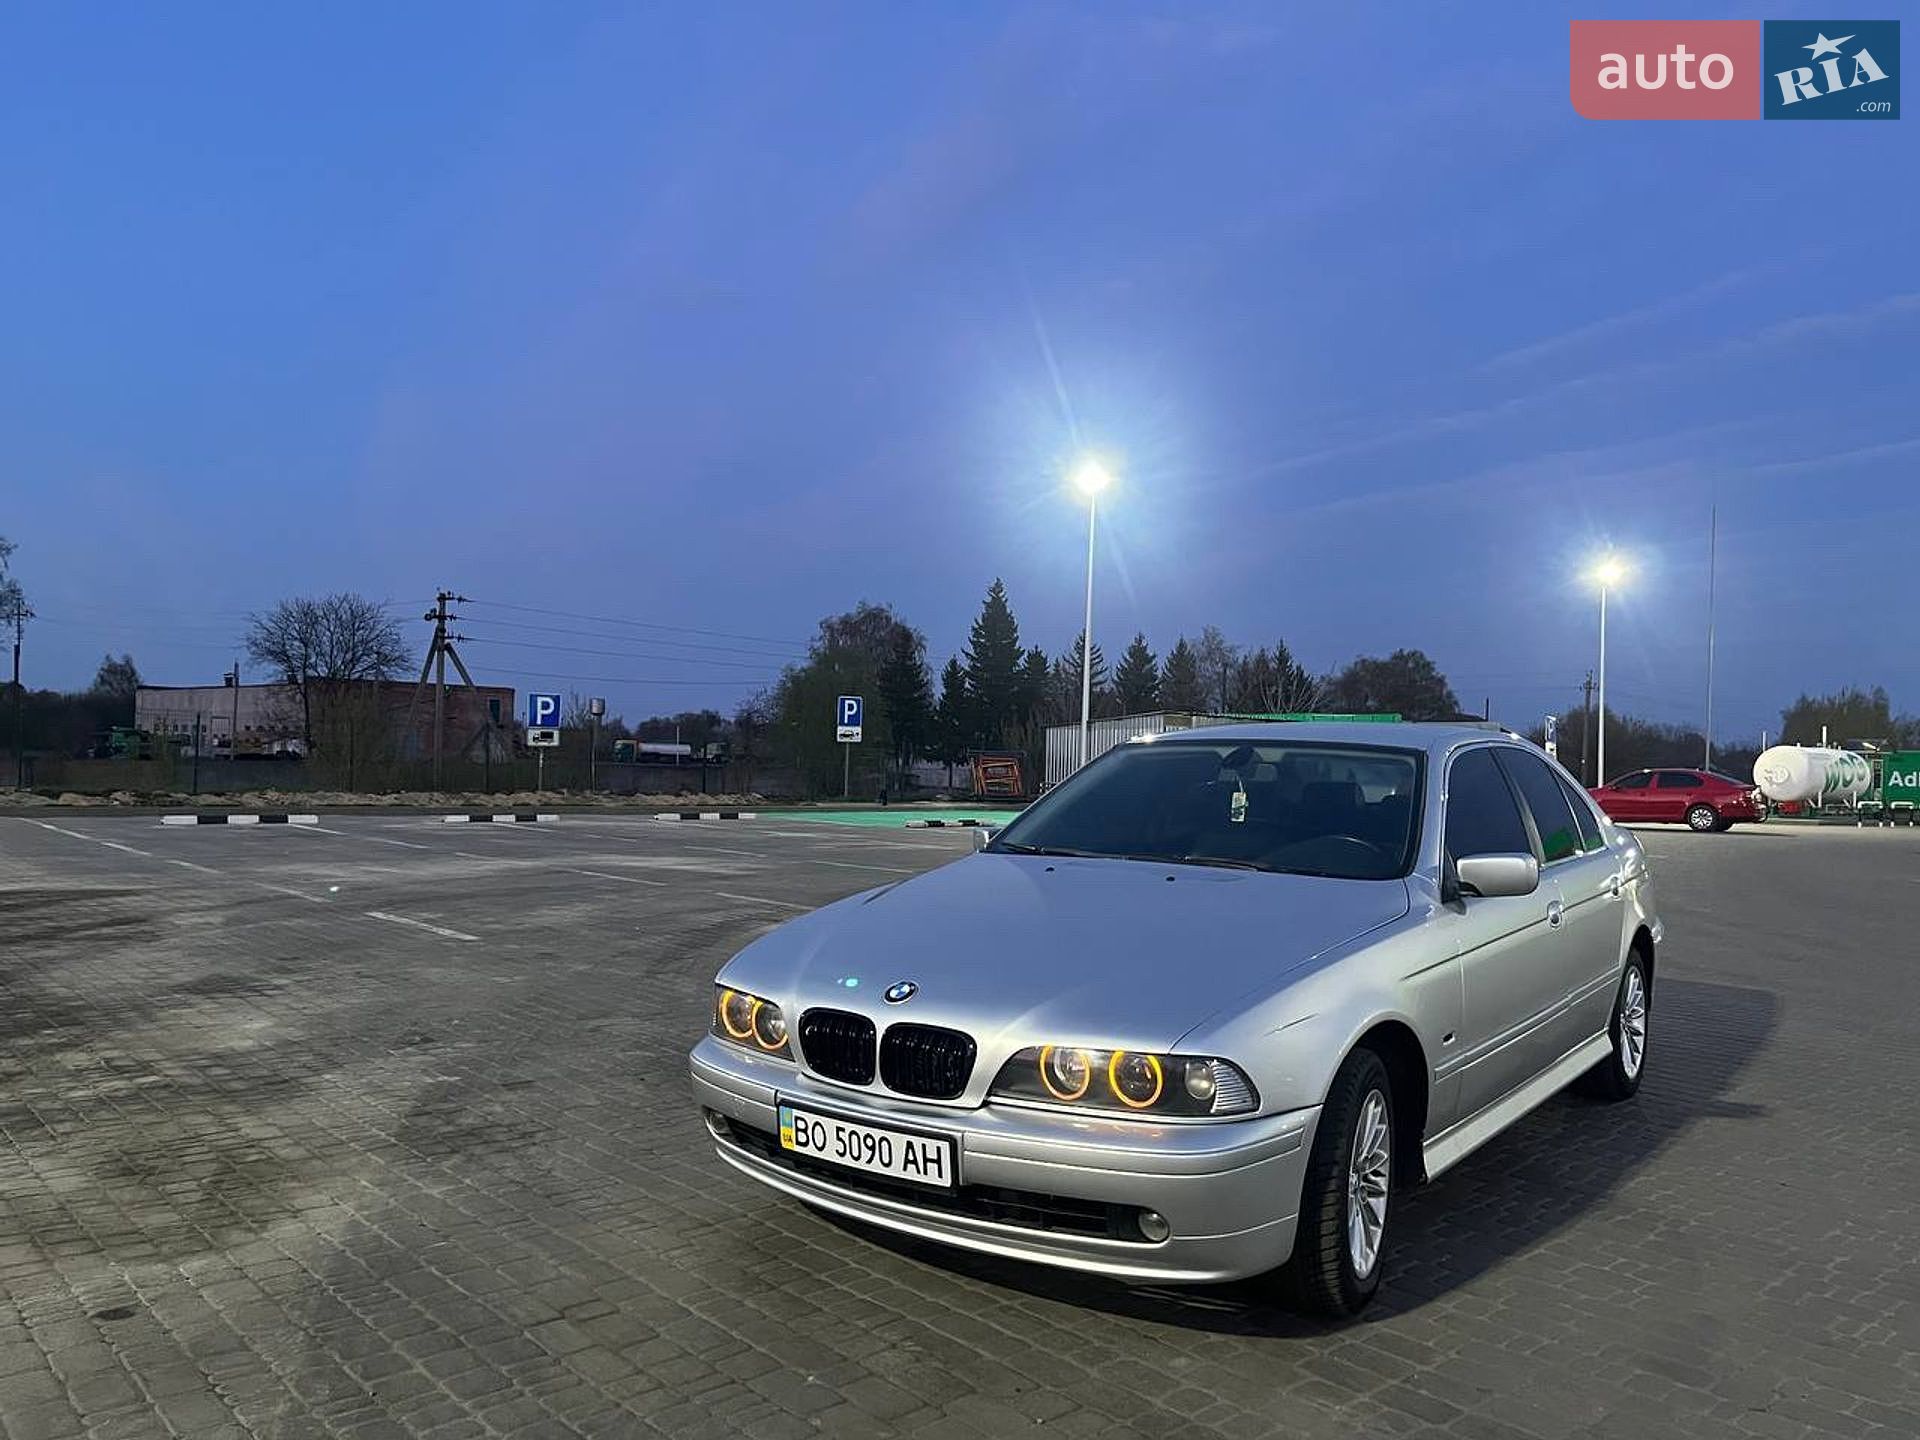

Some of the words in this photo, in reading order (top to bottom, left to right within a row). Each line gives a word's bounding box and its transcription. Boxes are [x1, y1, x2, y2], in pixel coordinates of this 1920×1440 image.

[536, 696, 555, 725] P
[844, 700, 857, 724] P
[1888, 770, 1920, 787] Ad
[794, 1115, 826, 1152] BO
[835, 1126, 893, 1168] 5090
[902, 1140, 943, 1178] AH
